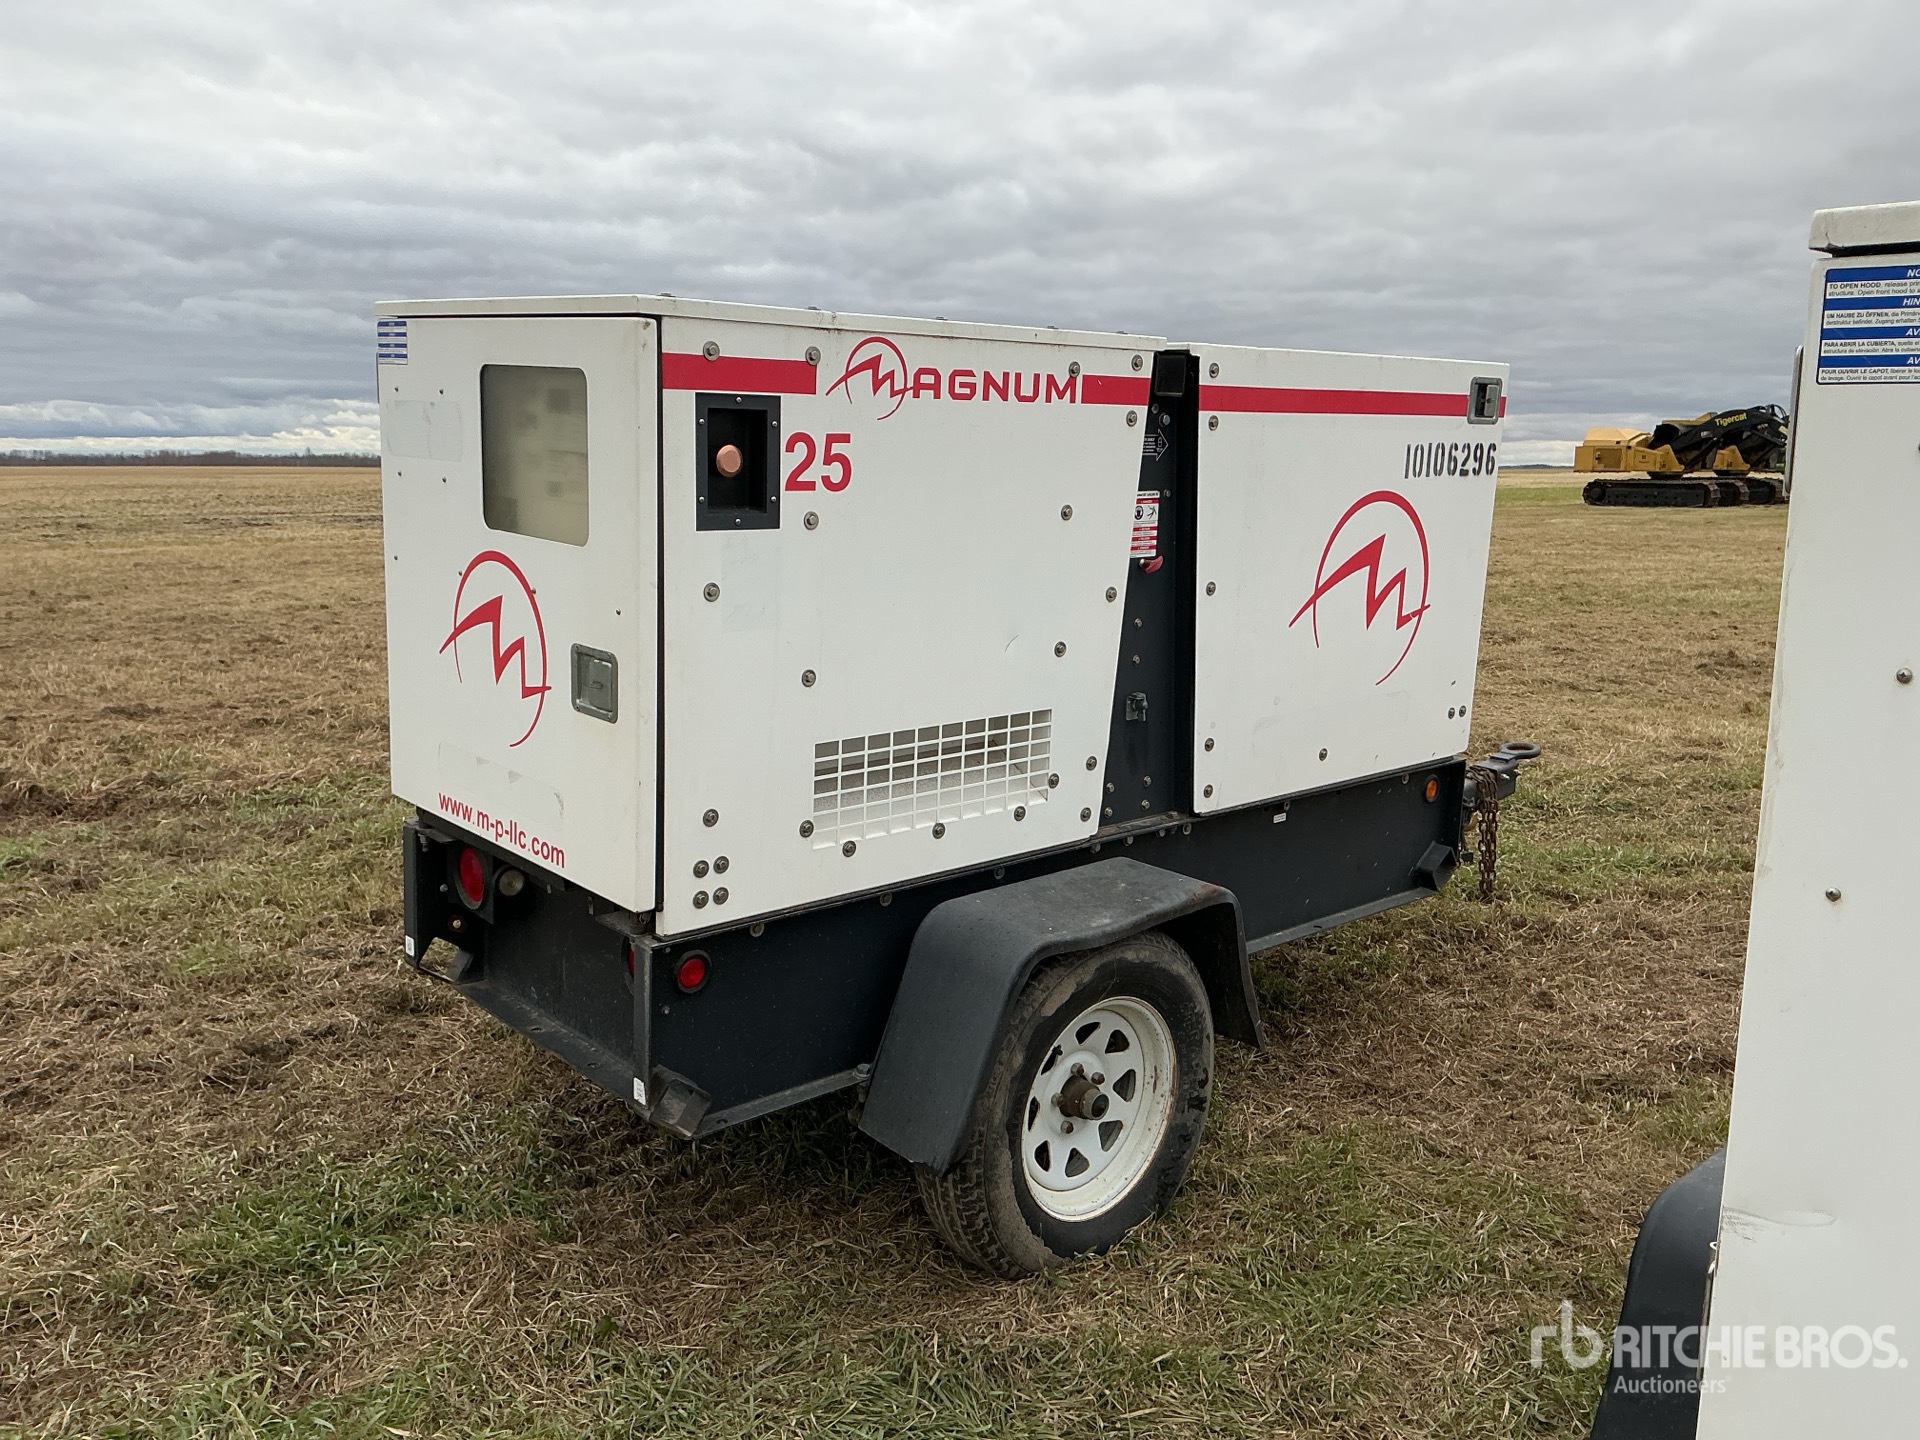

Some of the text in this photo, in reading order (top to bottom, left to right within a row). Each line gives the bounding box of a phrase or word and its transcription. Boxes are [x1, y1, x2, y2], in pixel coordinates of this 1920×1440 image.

[1840, 282, 1859, 290] OPEN
[1714, 412, 1748, 427] Tigercat
[785, 431, 853, 492] 25
[1404, 442, 1497, 479] 10106296
[438, 792, 565, 869] www.m-p-llc.com
